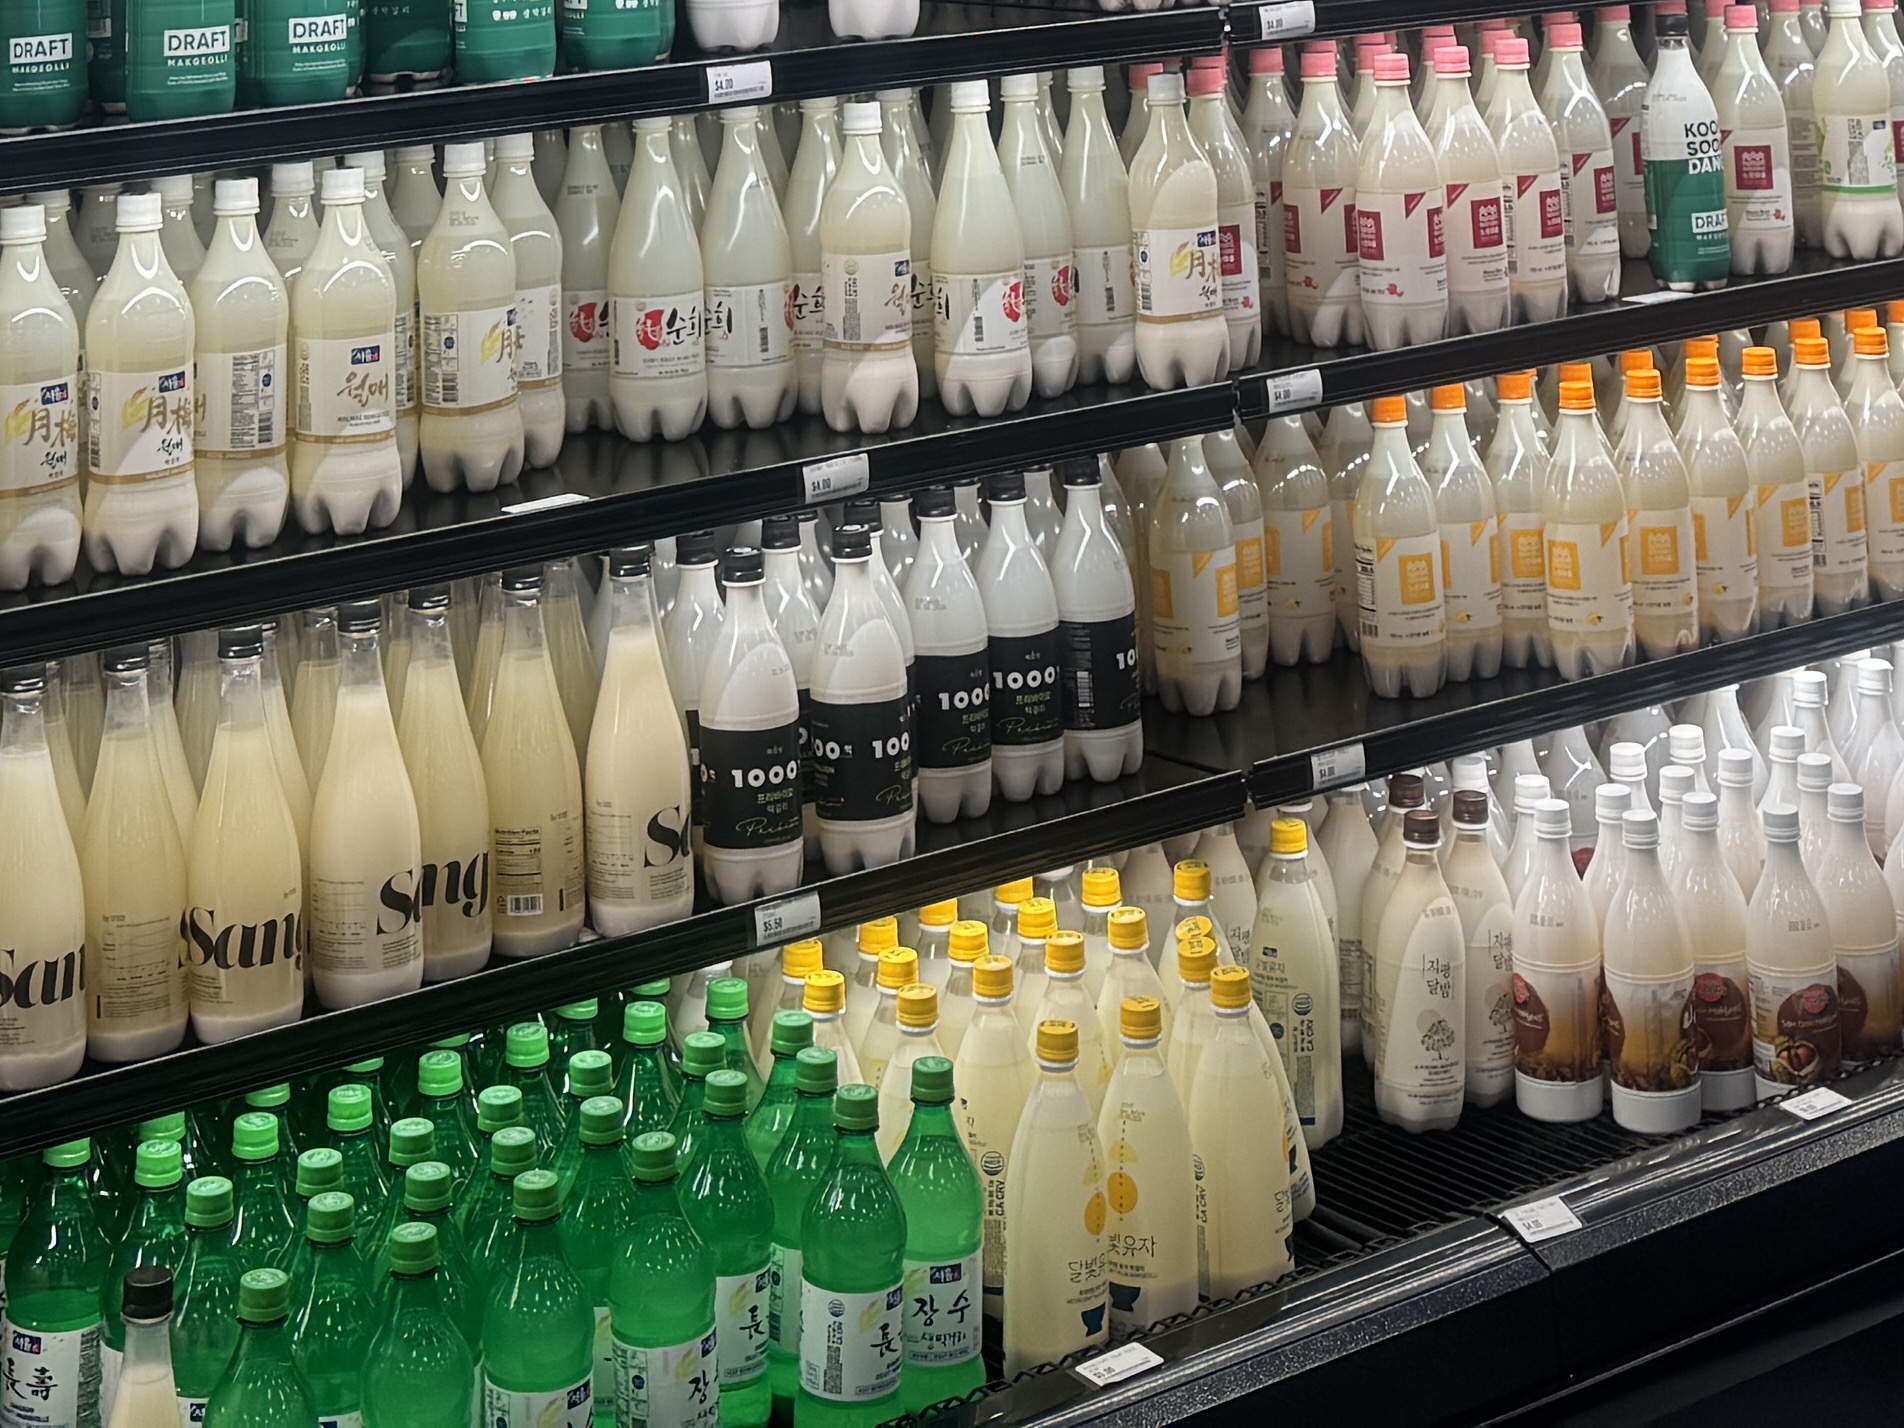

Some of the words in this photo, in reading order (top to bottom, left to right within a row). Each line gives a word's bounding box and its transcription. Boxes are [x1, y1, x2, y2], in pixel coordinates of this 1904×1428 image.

[292, 18, 346, 40] DRAFT
[14, 37, 69, 60] DRAFT
[167, 29, 227, 52] DRAFT
[1684, 121, 1720, 141] KOO
[1686, 139, 1722, 160] SOO
[1687, 157, 1725, 175] DAN
[1428, 959, 1451, 980] 지평
[912, 1289, 972, 1327] 장수
